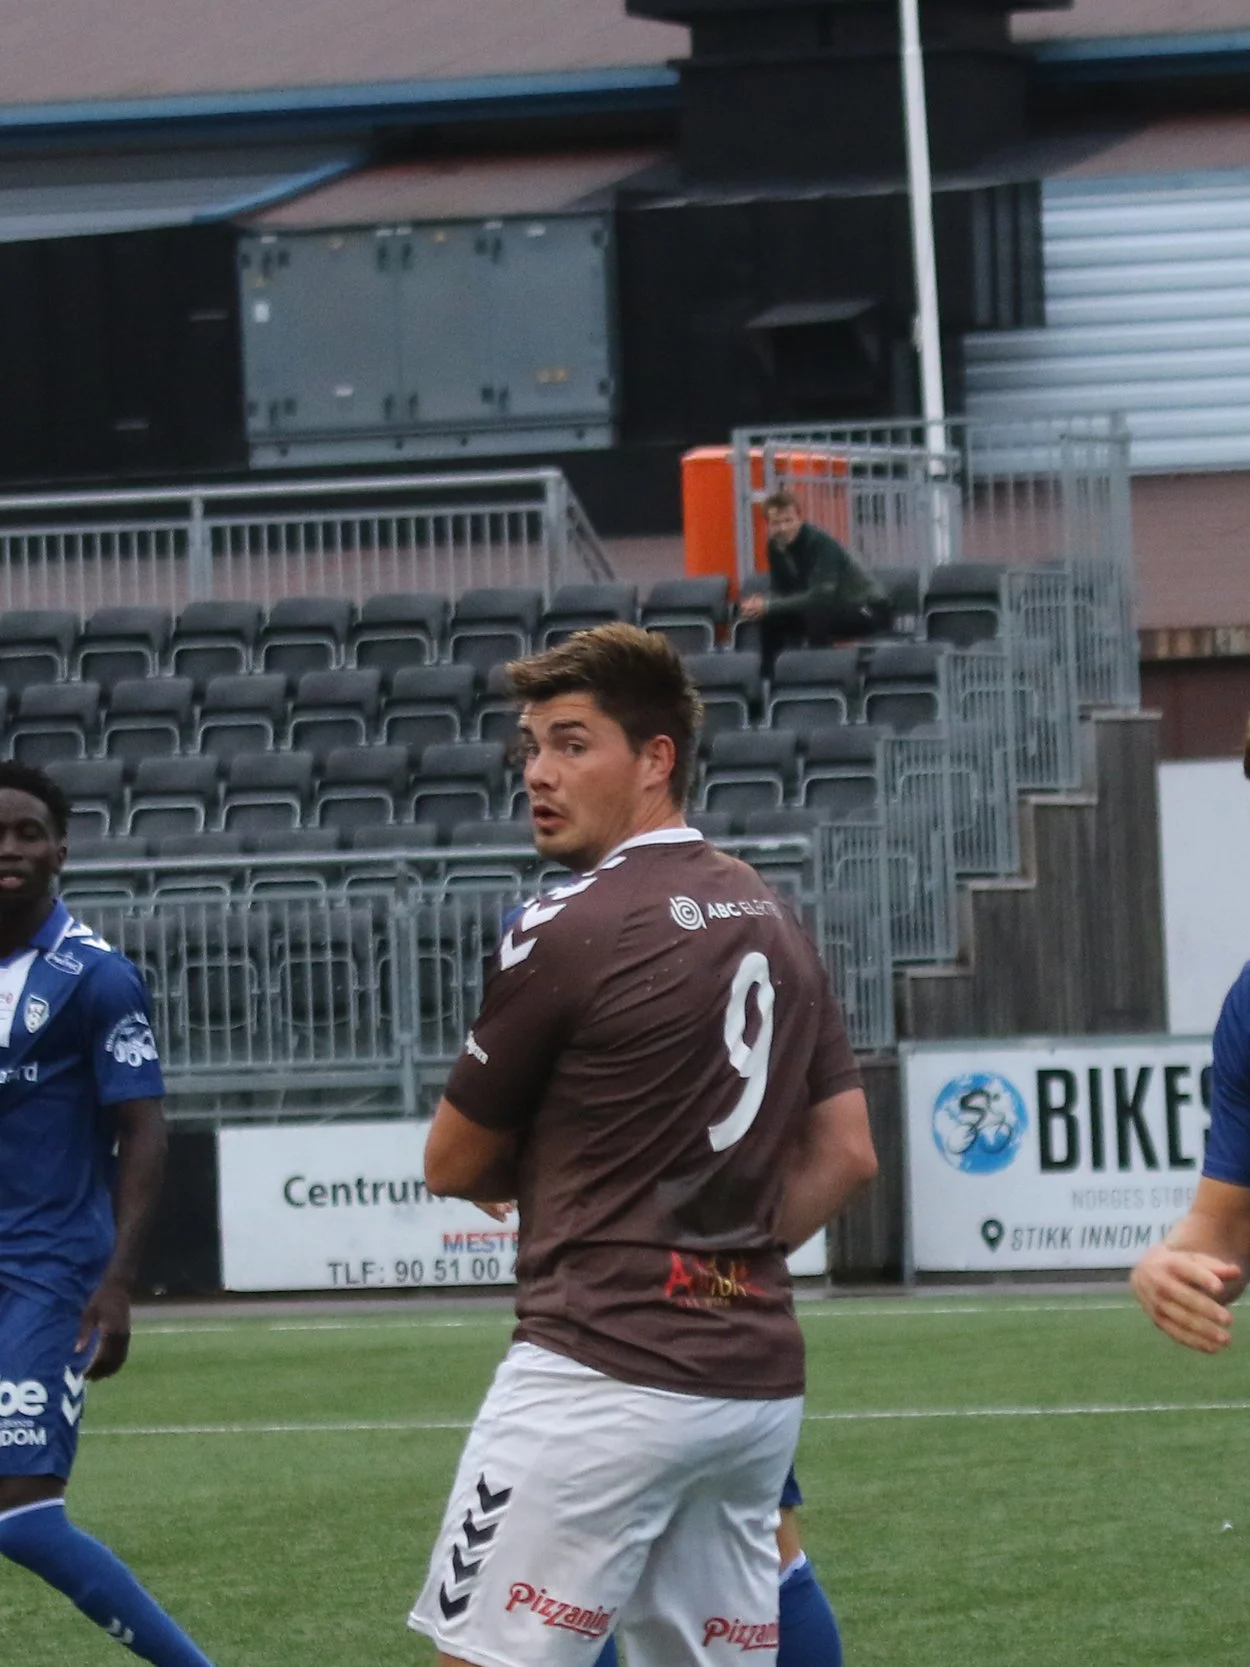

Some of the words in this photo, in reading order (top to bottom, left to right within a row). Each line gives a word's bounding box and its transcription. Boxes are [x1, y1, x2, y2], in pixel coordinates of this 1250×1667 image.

[707, 902, 742, 919] ABC
[708, 951, 776, 1153] 9
[1010, 1225, 1073, 1252] STIKK
[328, 1260, 385, 1285] TLF:
[394, 1259, 425, 1283] 90
[434, 1258, 461, 1282] 51
[471, 1257, 501, 1281] 00
